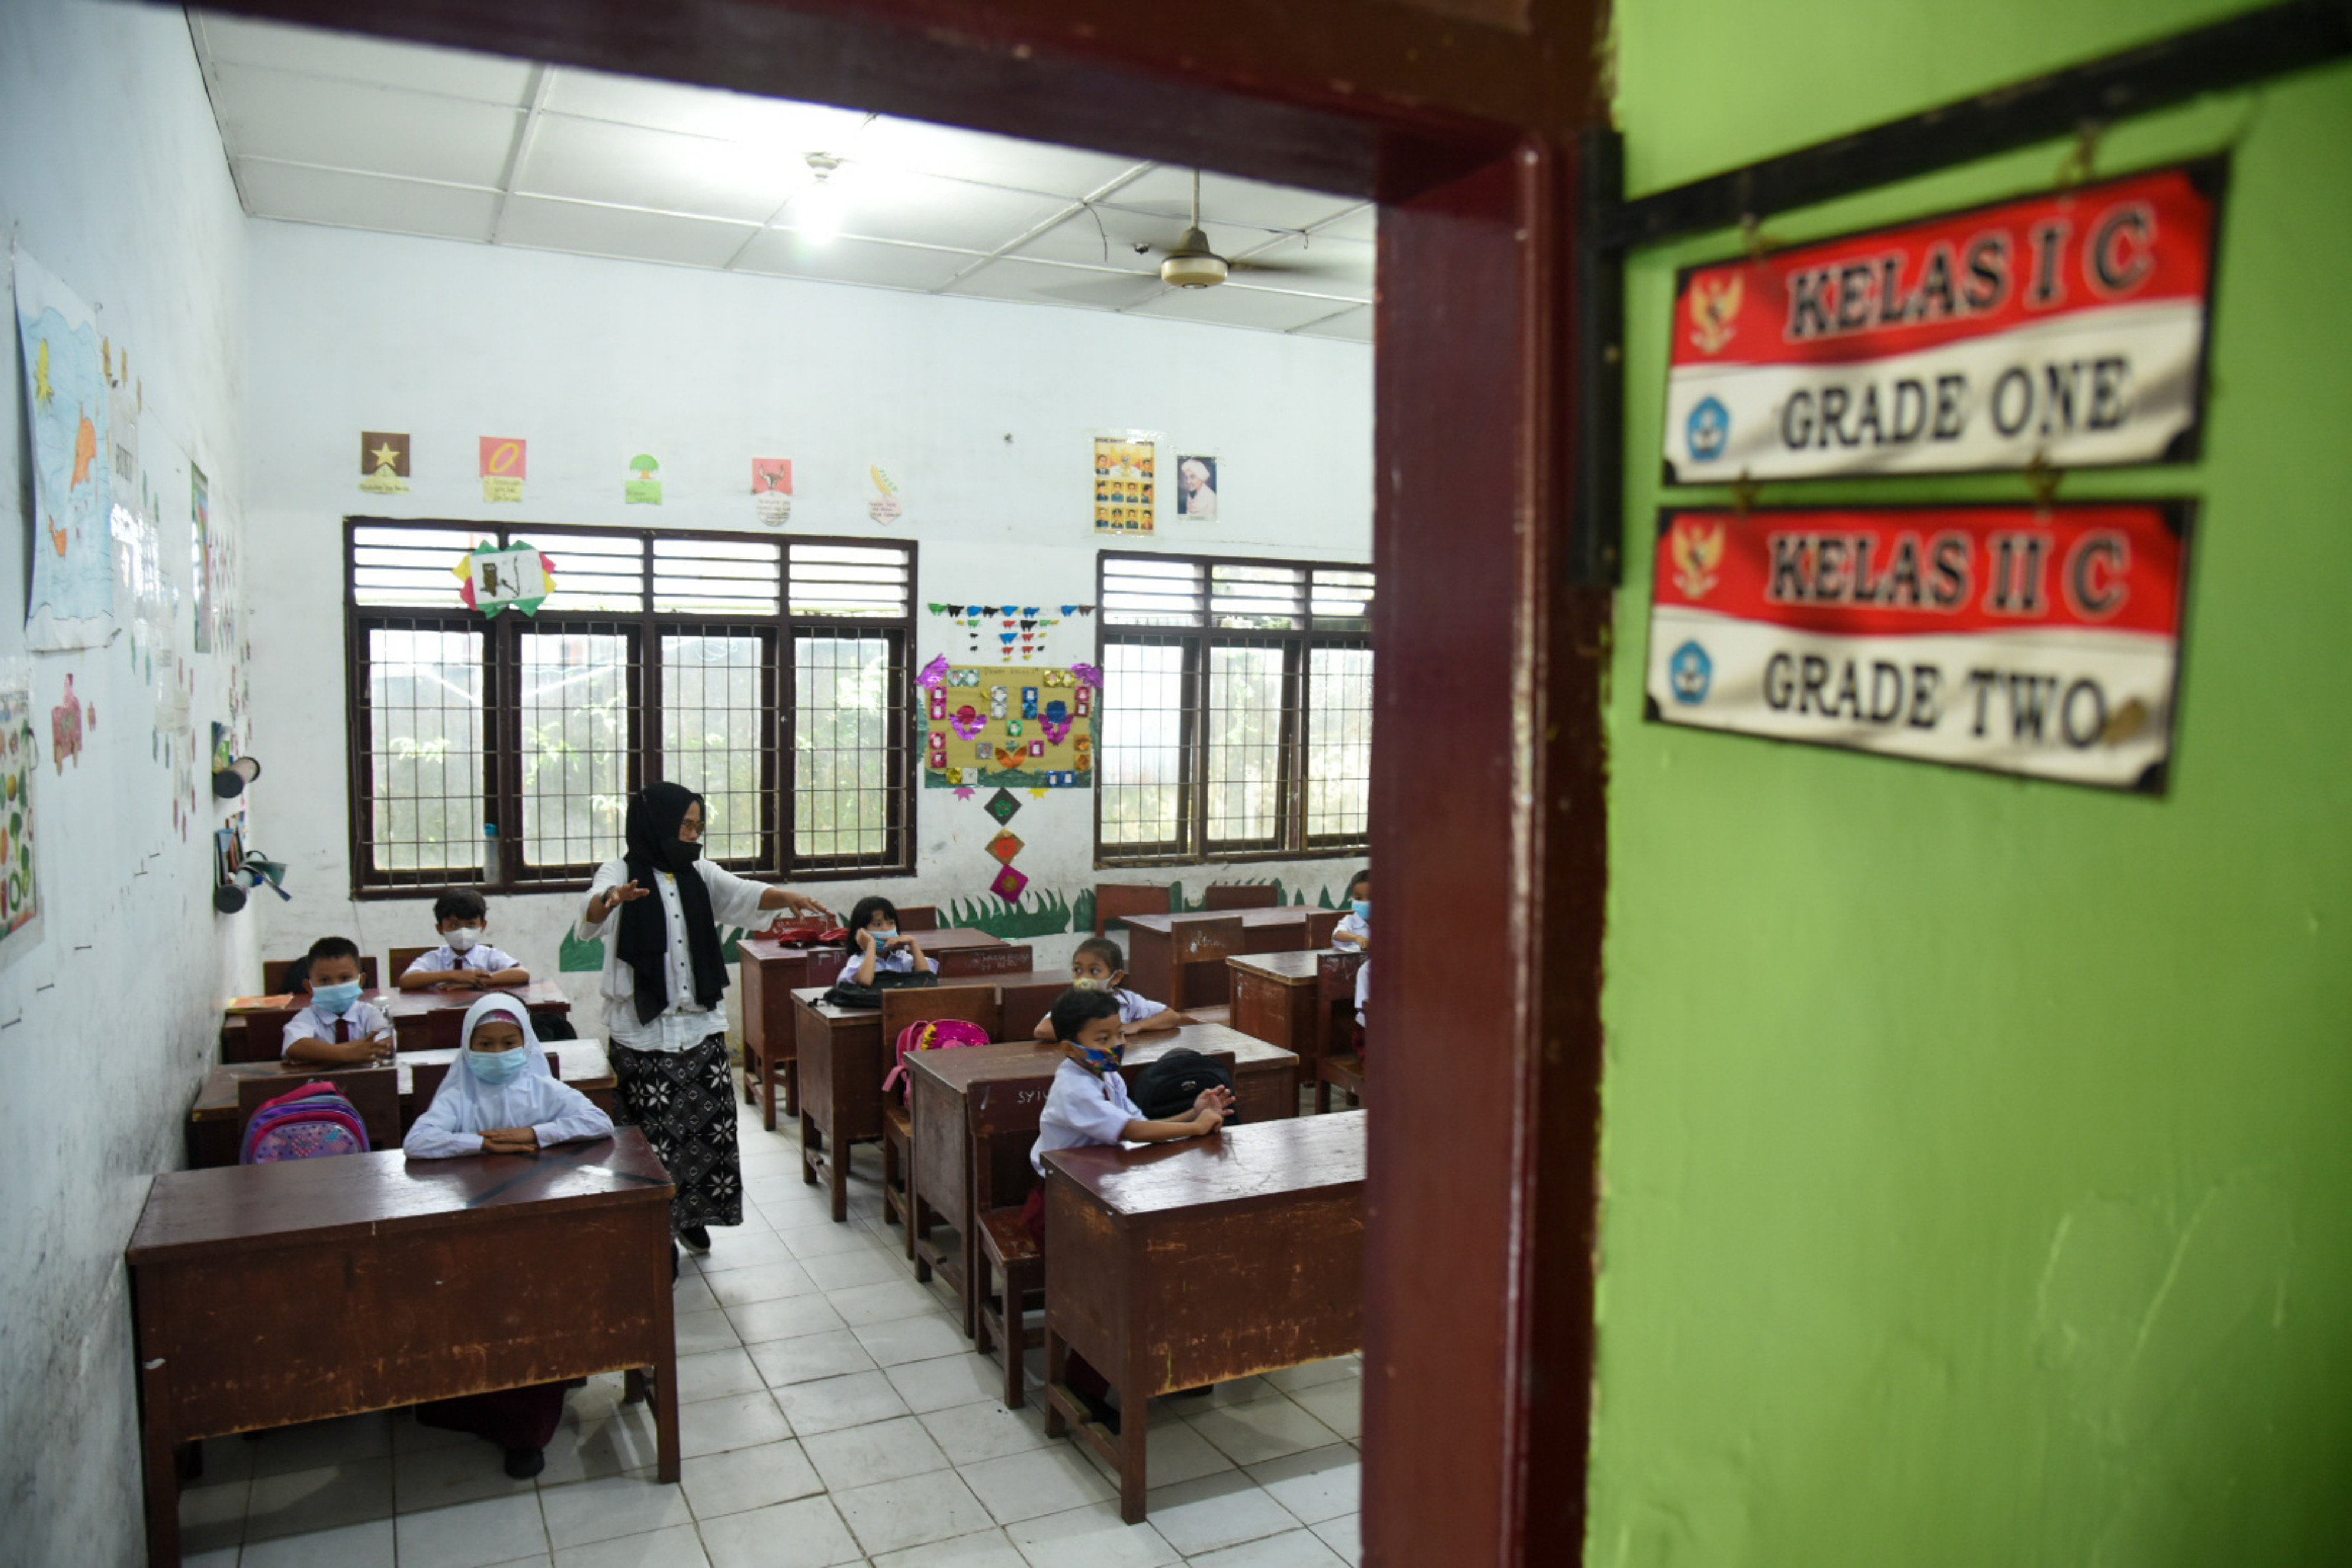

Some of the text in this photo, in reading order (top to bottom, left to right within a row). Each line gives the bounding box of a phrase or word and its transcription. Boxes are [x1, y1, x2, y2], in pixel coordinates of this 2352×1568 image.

[1786, 203, 2156, 341] KELAS I C
[1780, 357, 2129, 450] GRADE ONE
[1767, 530, 2130, 621] KELAS II C
[1764, 652, 2107, 748] GRADE TWO
